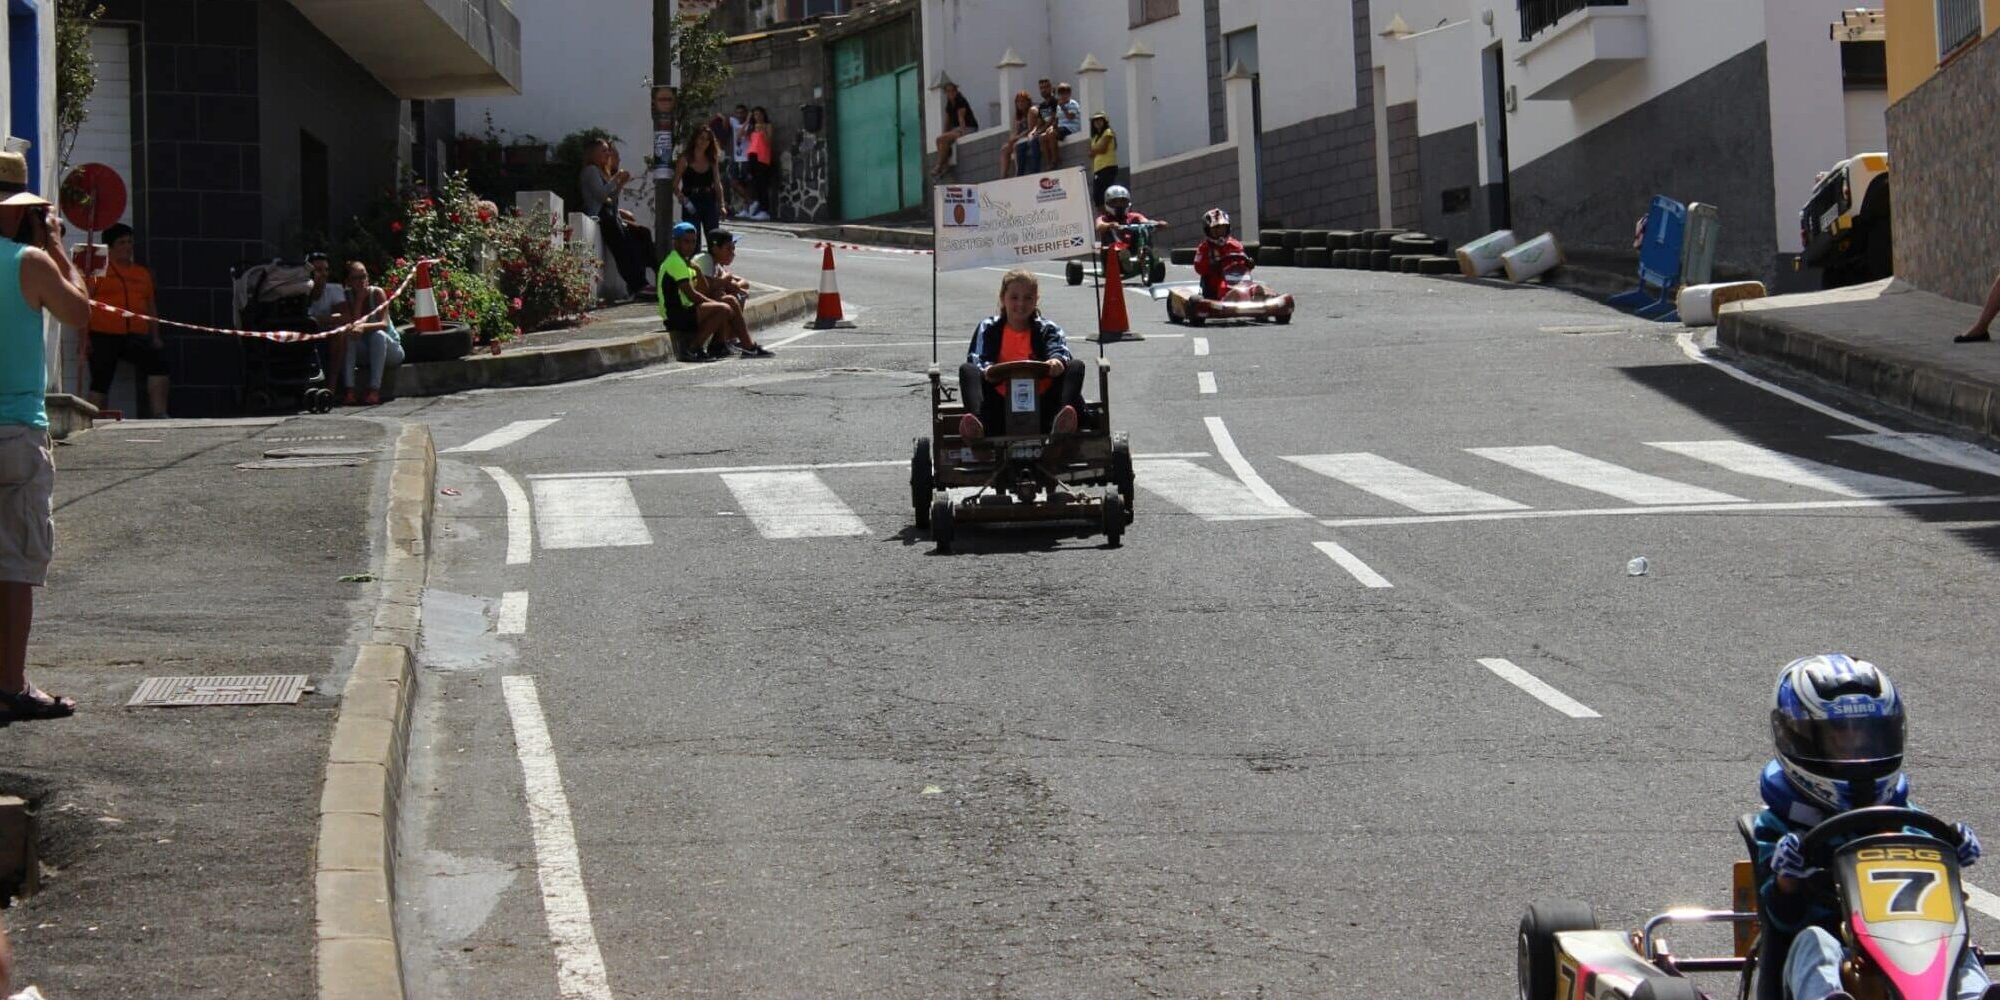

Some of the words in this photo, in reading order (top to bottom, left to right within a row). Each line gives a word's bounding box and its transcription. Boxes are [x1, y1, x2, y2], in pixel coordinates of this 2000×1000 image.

[978, 208, 1059, 231] sociación
[997, 229, 1019, 247] de
[1014, 239, 1071, 256] TENERIFE
[1833, 703, 1876, 714] SHIRO
[1857, 848, 1942, 861] CRG
[1869, 868, 1940, 915] 7
[1560, 961, 1577, 1000] 7
